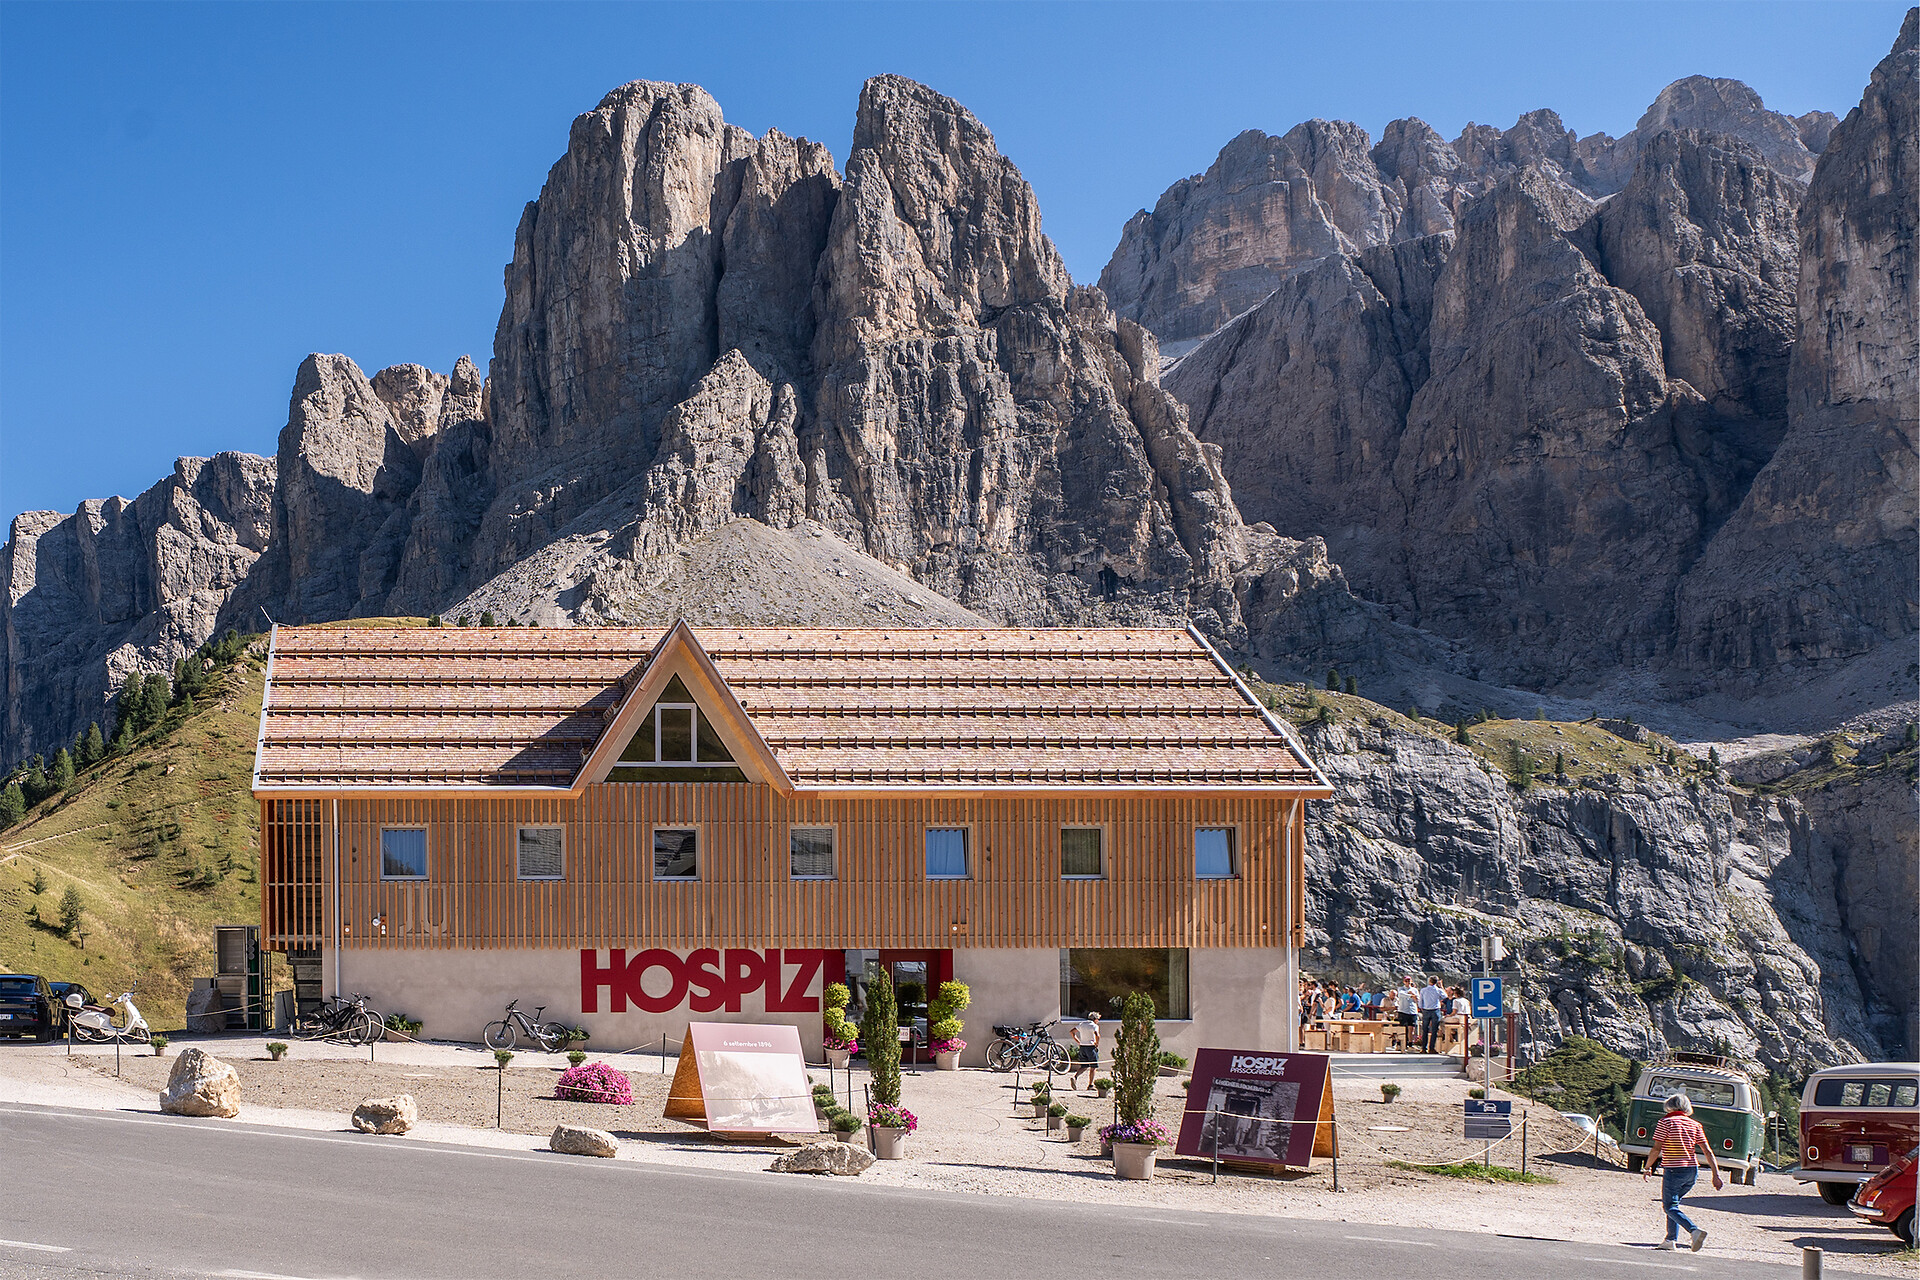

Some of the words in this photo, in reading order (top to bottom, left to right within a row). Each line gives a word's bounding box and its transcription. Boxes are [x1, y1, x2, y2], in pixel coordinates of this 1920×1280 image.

[581, 948, 823, 1013] HOSPIZ
[1479, 981, 1495, 999] P
[1231, 1055, 1288, 1070] HOSPIZ
